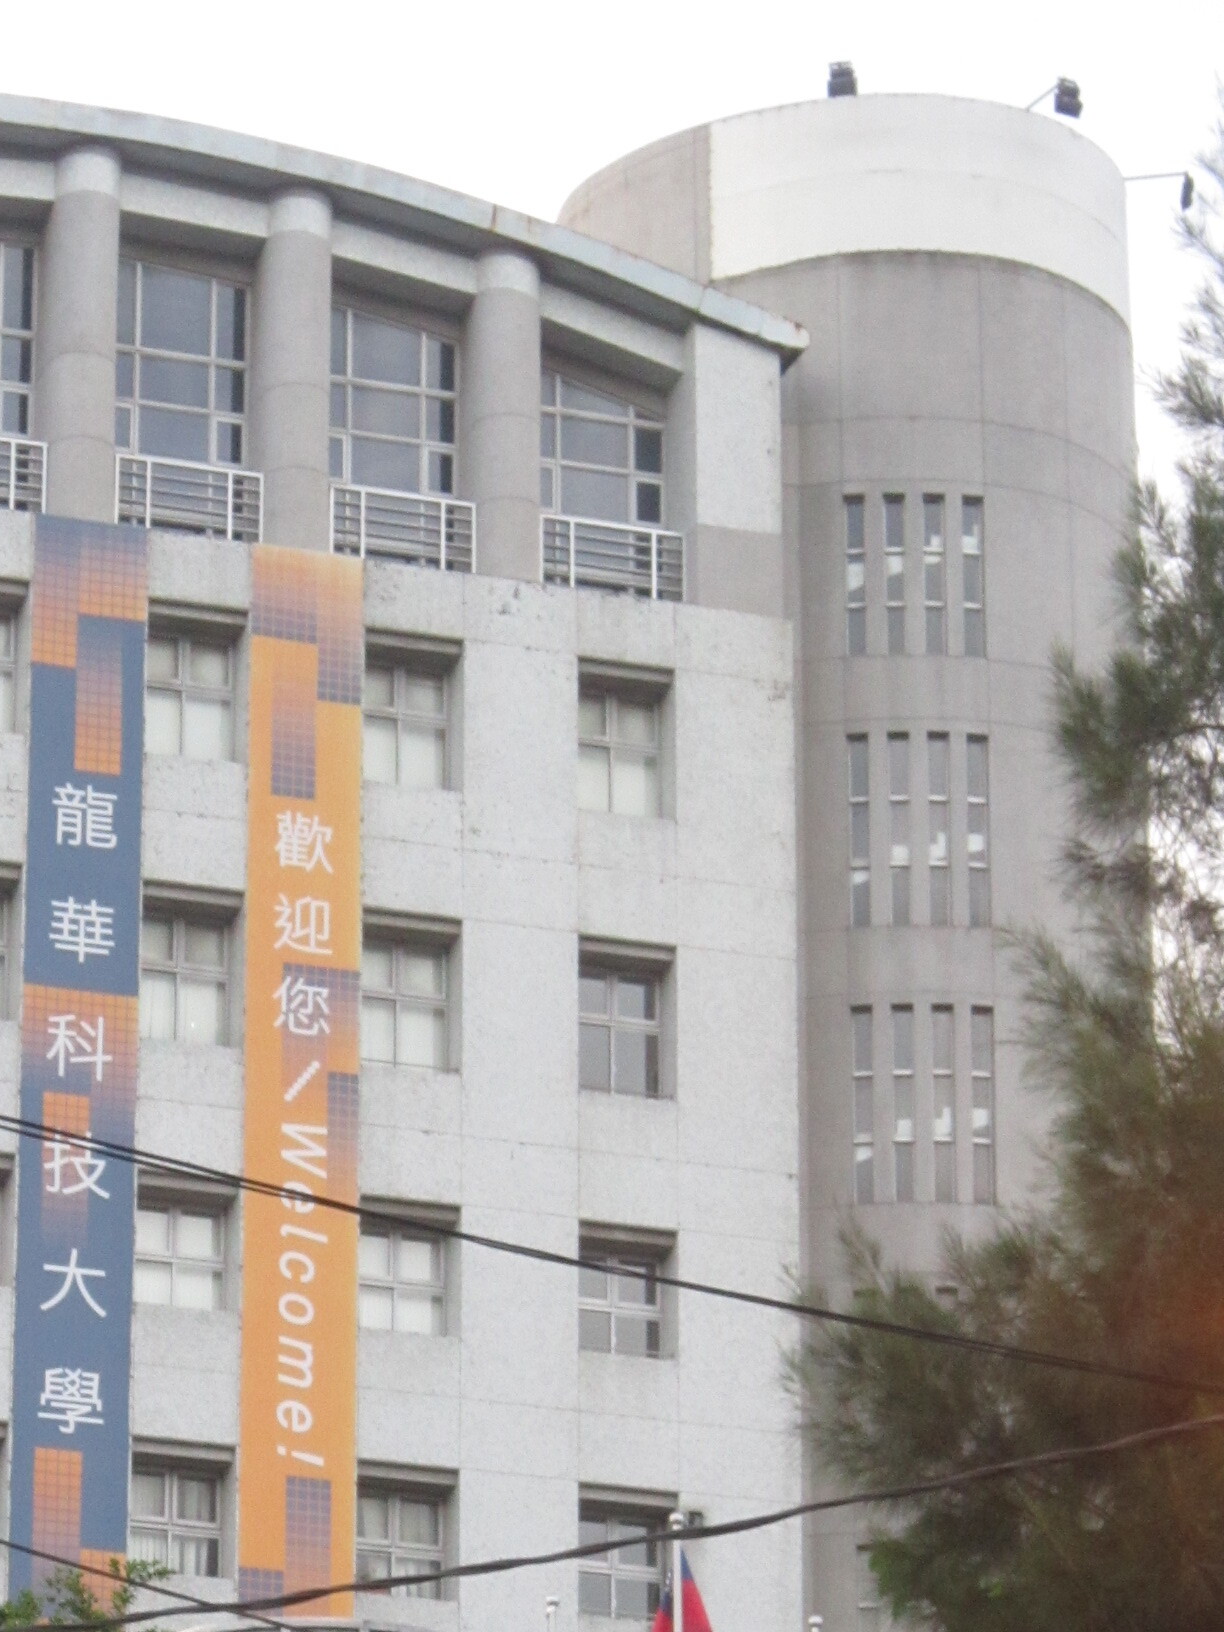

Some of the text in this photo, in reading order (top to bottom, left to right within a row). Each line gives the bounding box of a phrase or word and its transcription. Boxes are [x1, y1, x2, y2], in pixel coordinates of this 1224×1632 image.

[36, 782, 119, 1436] 龍華科技大學
